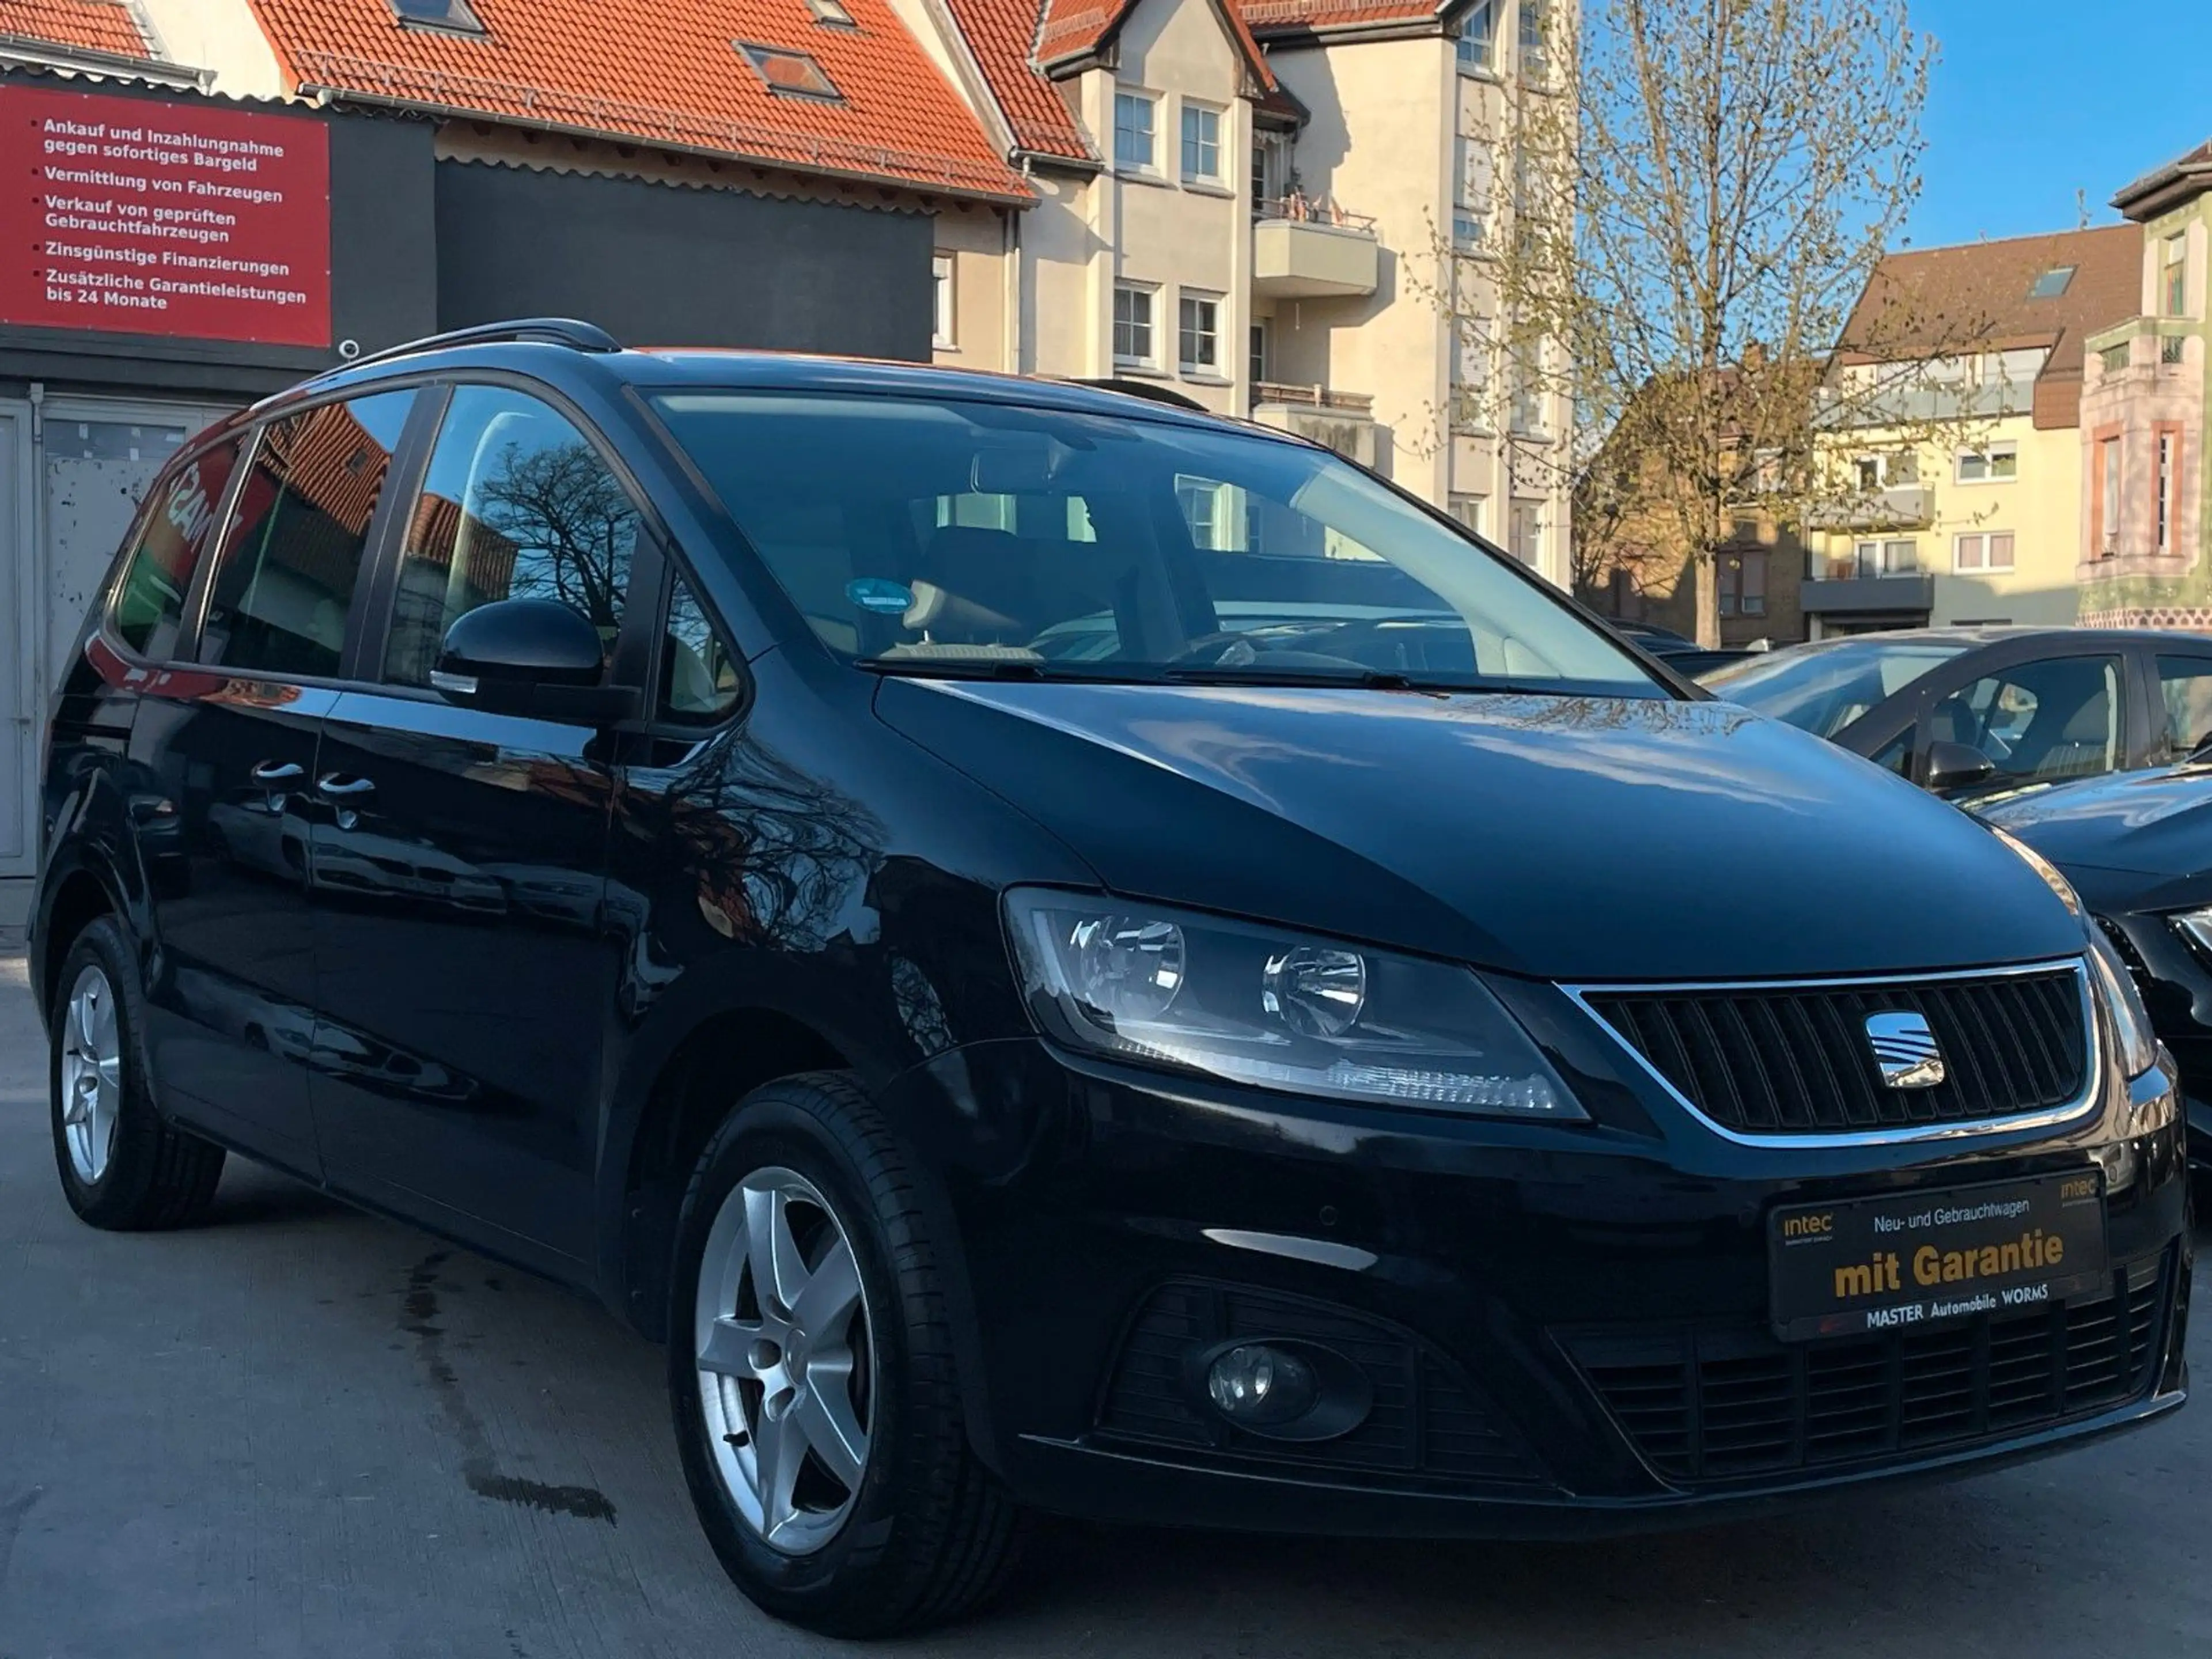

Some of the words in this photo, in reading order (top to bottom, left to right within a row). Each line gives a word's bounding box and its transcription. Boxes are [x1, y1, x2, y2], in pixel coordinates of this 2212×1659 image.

[44, 119, 105, 138] Ankauf
[110, 128, 142, 142] und
[147, 130, 285, 157] Inzahlungnahme
[44, 139, 98, 156] gegen
[103, 145, 188, 165] sofortiges
[194, 152, 257, 172] Bargeld
[44, 166, 146, 192] Vermittlung
[151, 179, 183, 193] von
[187, 180, 283, 204] Fahrzeugen
[45, 195, 112, 214] Verkauf
[117, 204, 148, 217] von
[153, 208, 236, 225] geprüften
[45, 213, 230, 244] Gebrauchtfahrzeugen
[46, 240, 157, 266] Zinsgünstige
[162, 252, 290, 276] Finanzierungen
[47, 268, 144, 290] Zusätzliche
[149, 278, 306, 305] Garantieleistungen
[47, 286, 72, 302] bis
[78, 289, 99, 304] 24
[104, 291, 168, 309] Monate
[1874, 1215, 1905, 1232] Neu-
[1908, 1211, 1931, 1228] und
[1934, 1199, 2031, 1225] Gebrauchtwagen
[1834, 1252, 1900, 1297] mit
[1913, 1228, 2064, 1286] Garantie
[1867, 1304, 1924, 1328] MASTER
[1930, 1294, 1997, 1317] Automobile
[2001, 1283, 2049, 1305] WORMS
